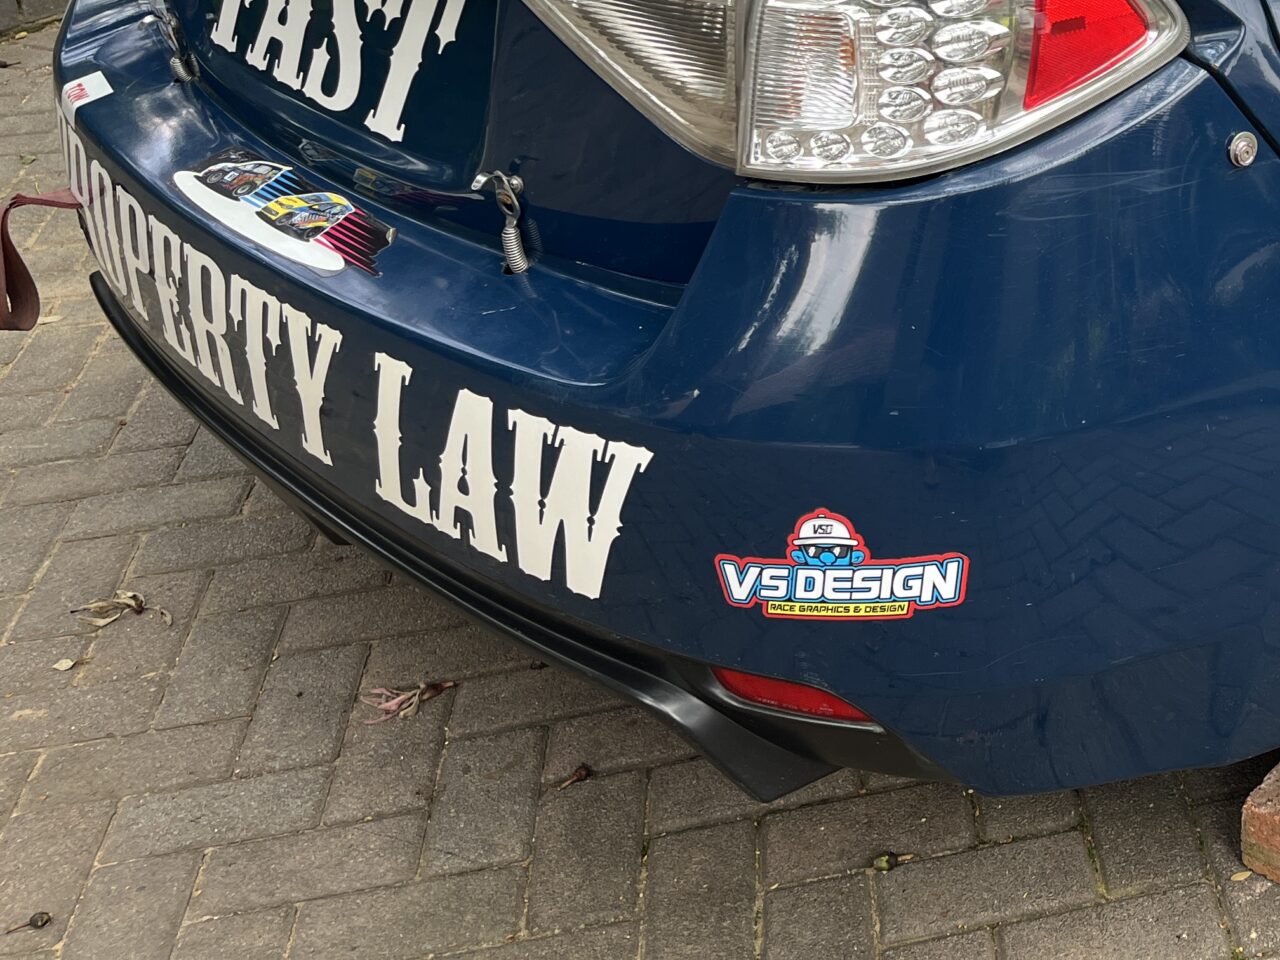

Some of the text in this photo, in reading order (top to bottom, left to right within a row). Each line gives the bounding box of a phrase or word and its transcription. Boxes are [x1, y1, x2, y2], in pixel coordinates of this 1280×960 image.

[374, 352, 655, 600] LAW
[812, 524, 834, 535] VSD
[721, 561, 959, 602] VS DESIGN
[769, 603, 906, 614] RACE GRAPHICS & DESIGN
